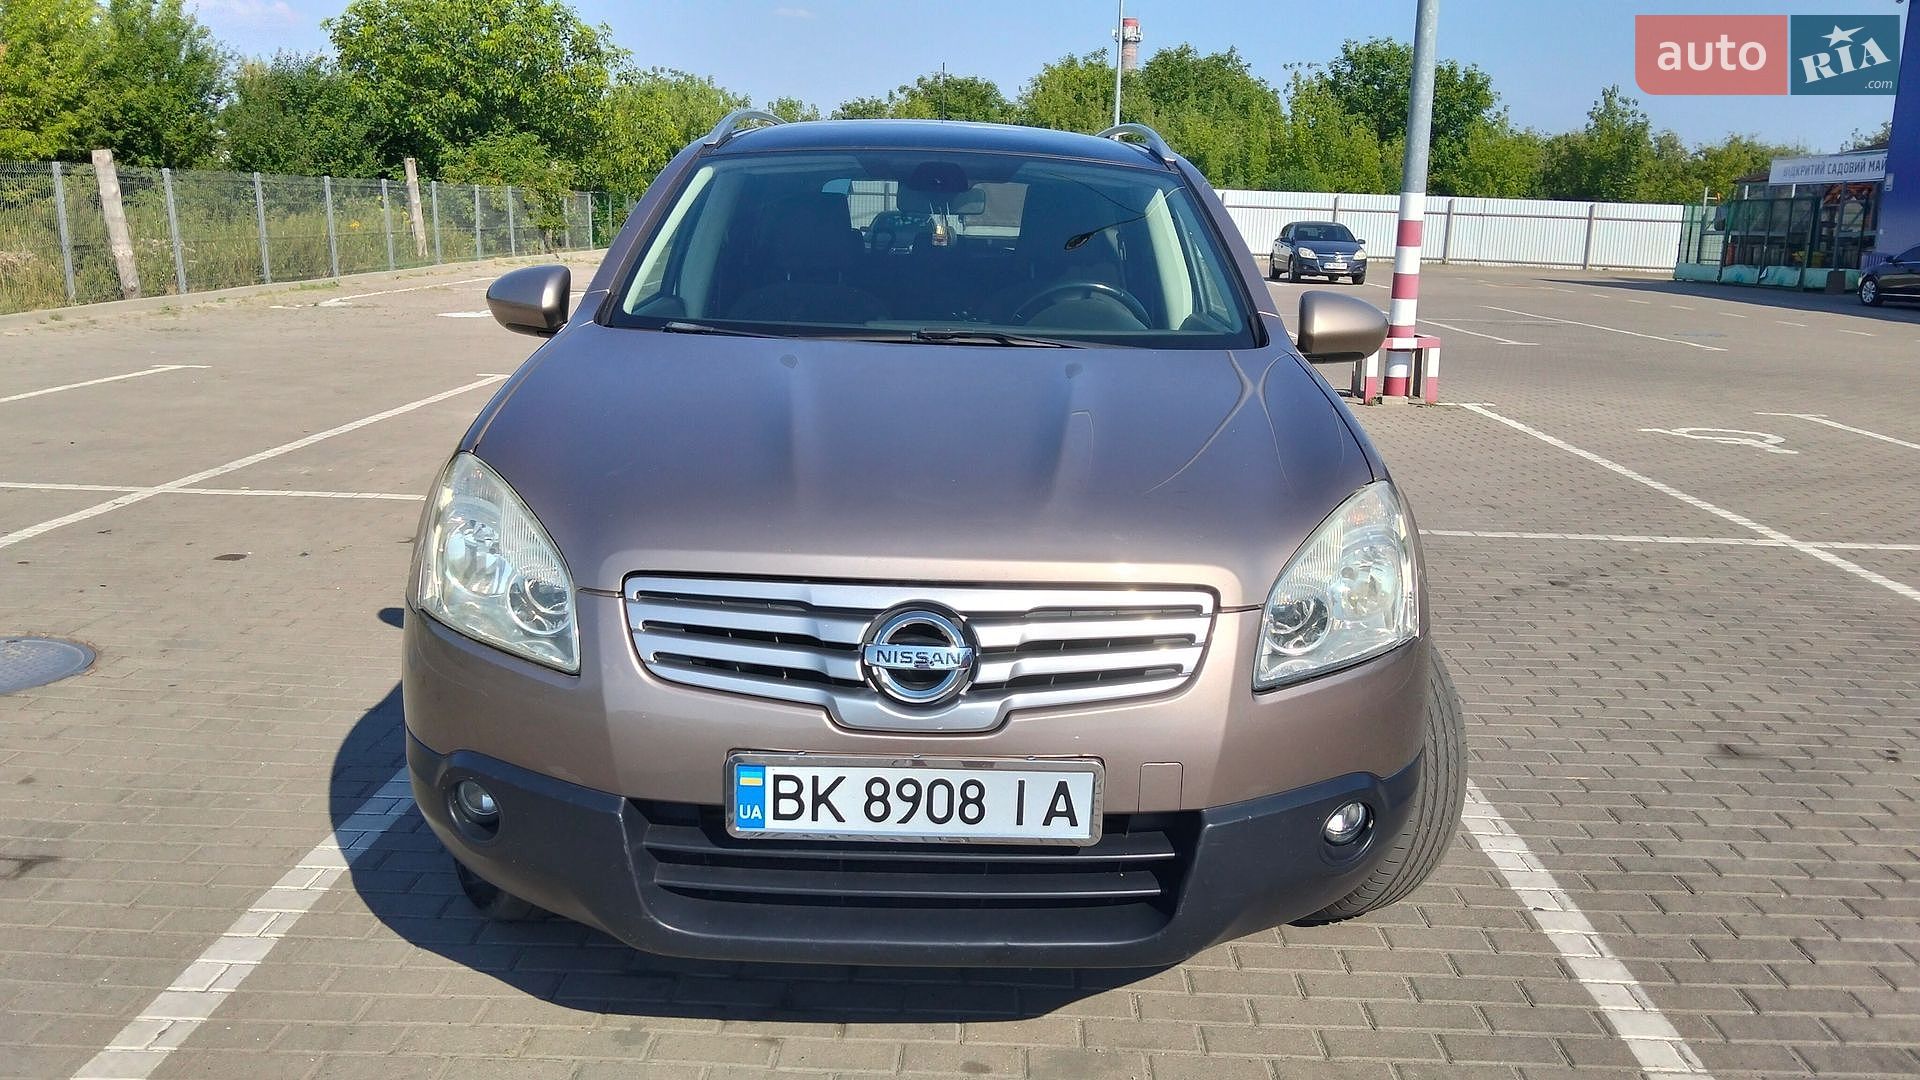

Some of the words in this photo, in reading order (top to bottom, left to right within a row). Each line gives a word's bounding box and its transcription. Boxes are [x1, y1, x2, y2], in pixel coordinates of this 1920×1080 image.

[1827, 159, 1867, 176] САДОВИЙ
[876, 649, 961, 665] NISSAN
[771, 774, 847, 824] BK
[863, 777, 986, 826] 8908
[739, 803, 763, 820] UA
